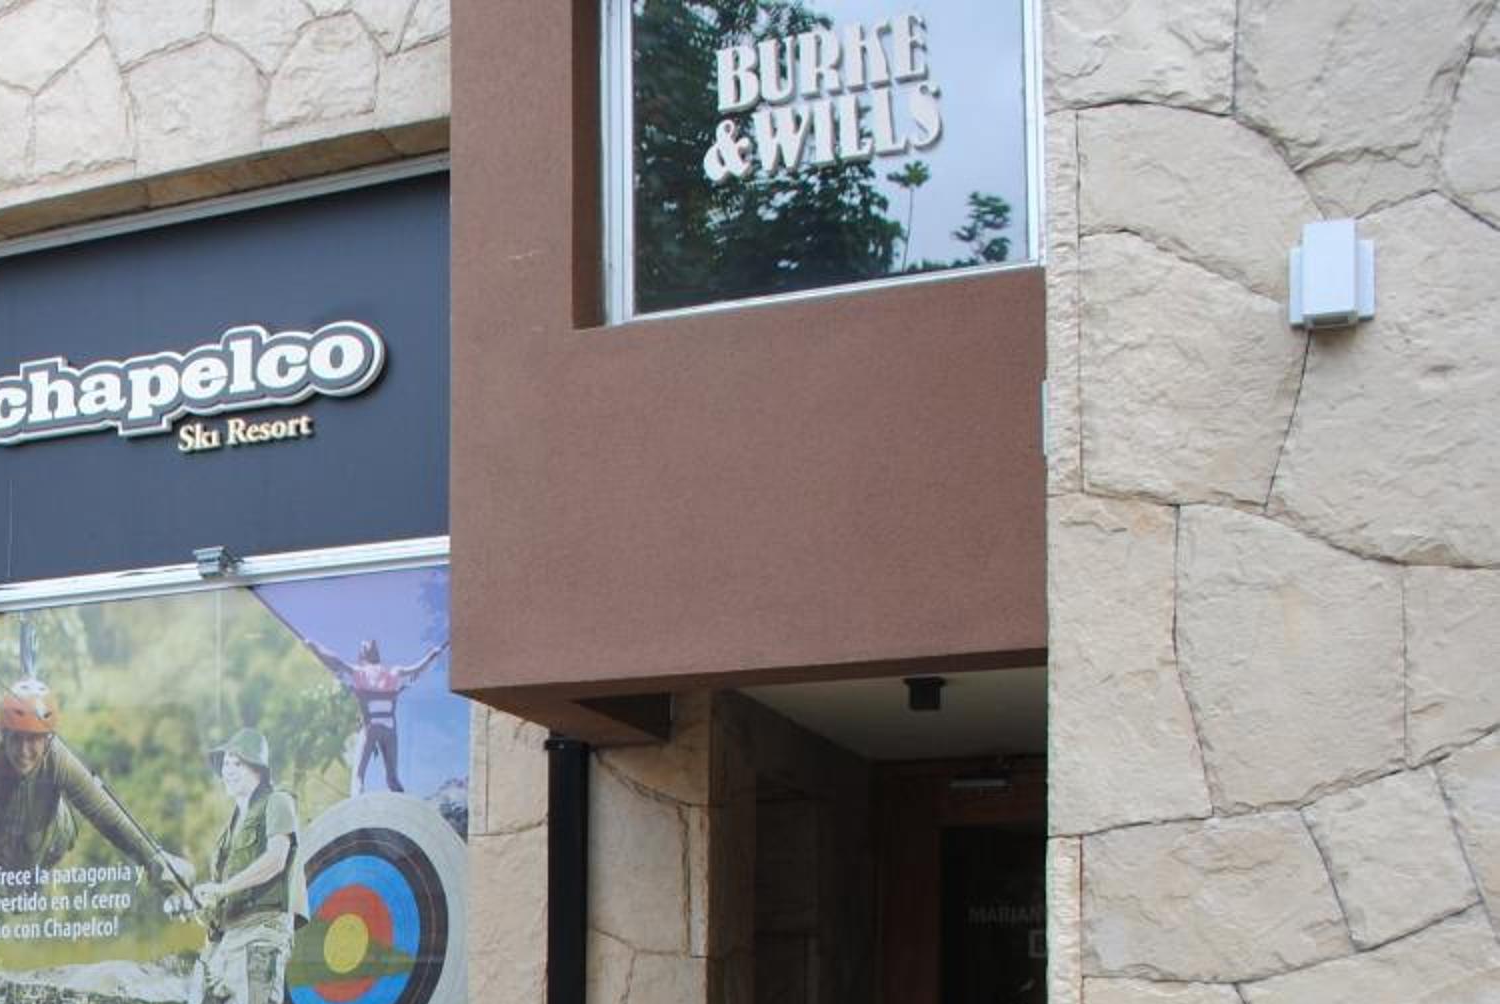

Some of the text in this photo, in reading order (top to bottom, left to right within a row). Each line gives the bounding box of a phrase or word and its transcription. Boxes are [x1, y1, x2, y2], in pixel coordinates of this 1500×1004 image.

[717, 14, 929, 113] BURKE
[178, 415, 312, 451] Ski Resort
[35, 864, 49, 884] la
[53, 864, 132, 891] patagonia
[135, 865, 145, 887] y
[51, 894, 68, 911] en
[73, 890, 88, 910] el
[91, 892, 131, 909] cerro
[14, 922, 41, 939] con
[44, 917, 119, 941] Chapelco!
